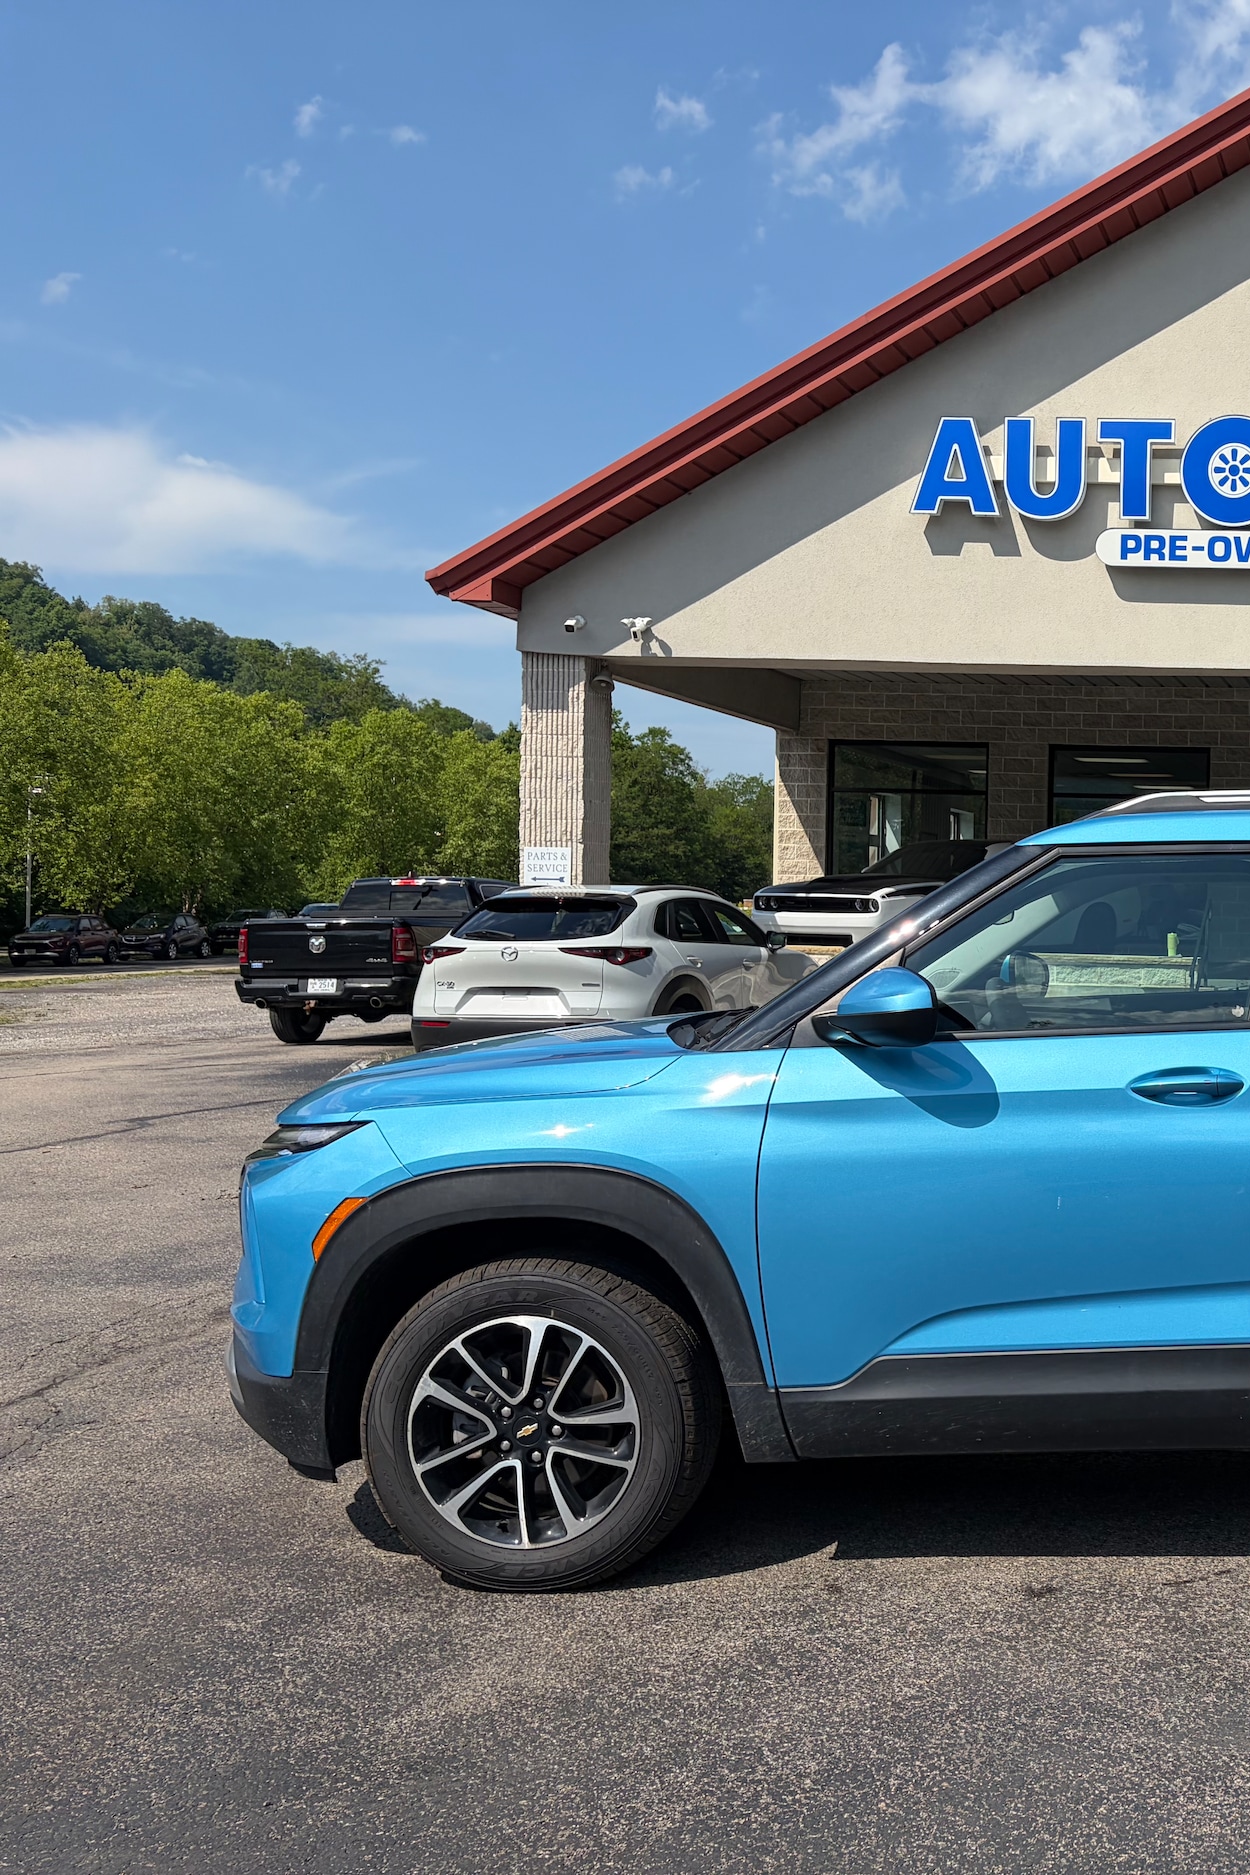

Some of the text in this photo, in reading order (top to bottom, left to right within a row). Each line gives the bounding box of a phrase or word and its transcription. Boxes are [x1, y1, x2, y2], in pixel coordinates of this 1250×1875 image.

[527, 851, 567, 861] PARTS &
[527, 863, 568, 873] SERVICE
